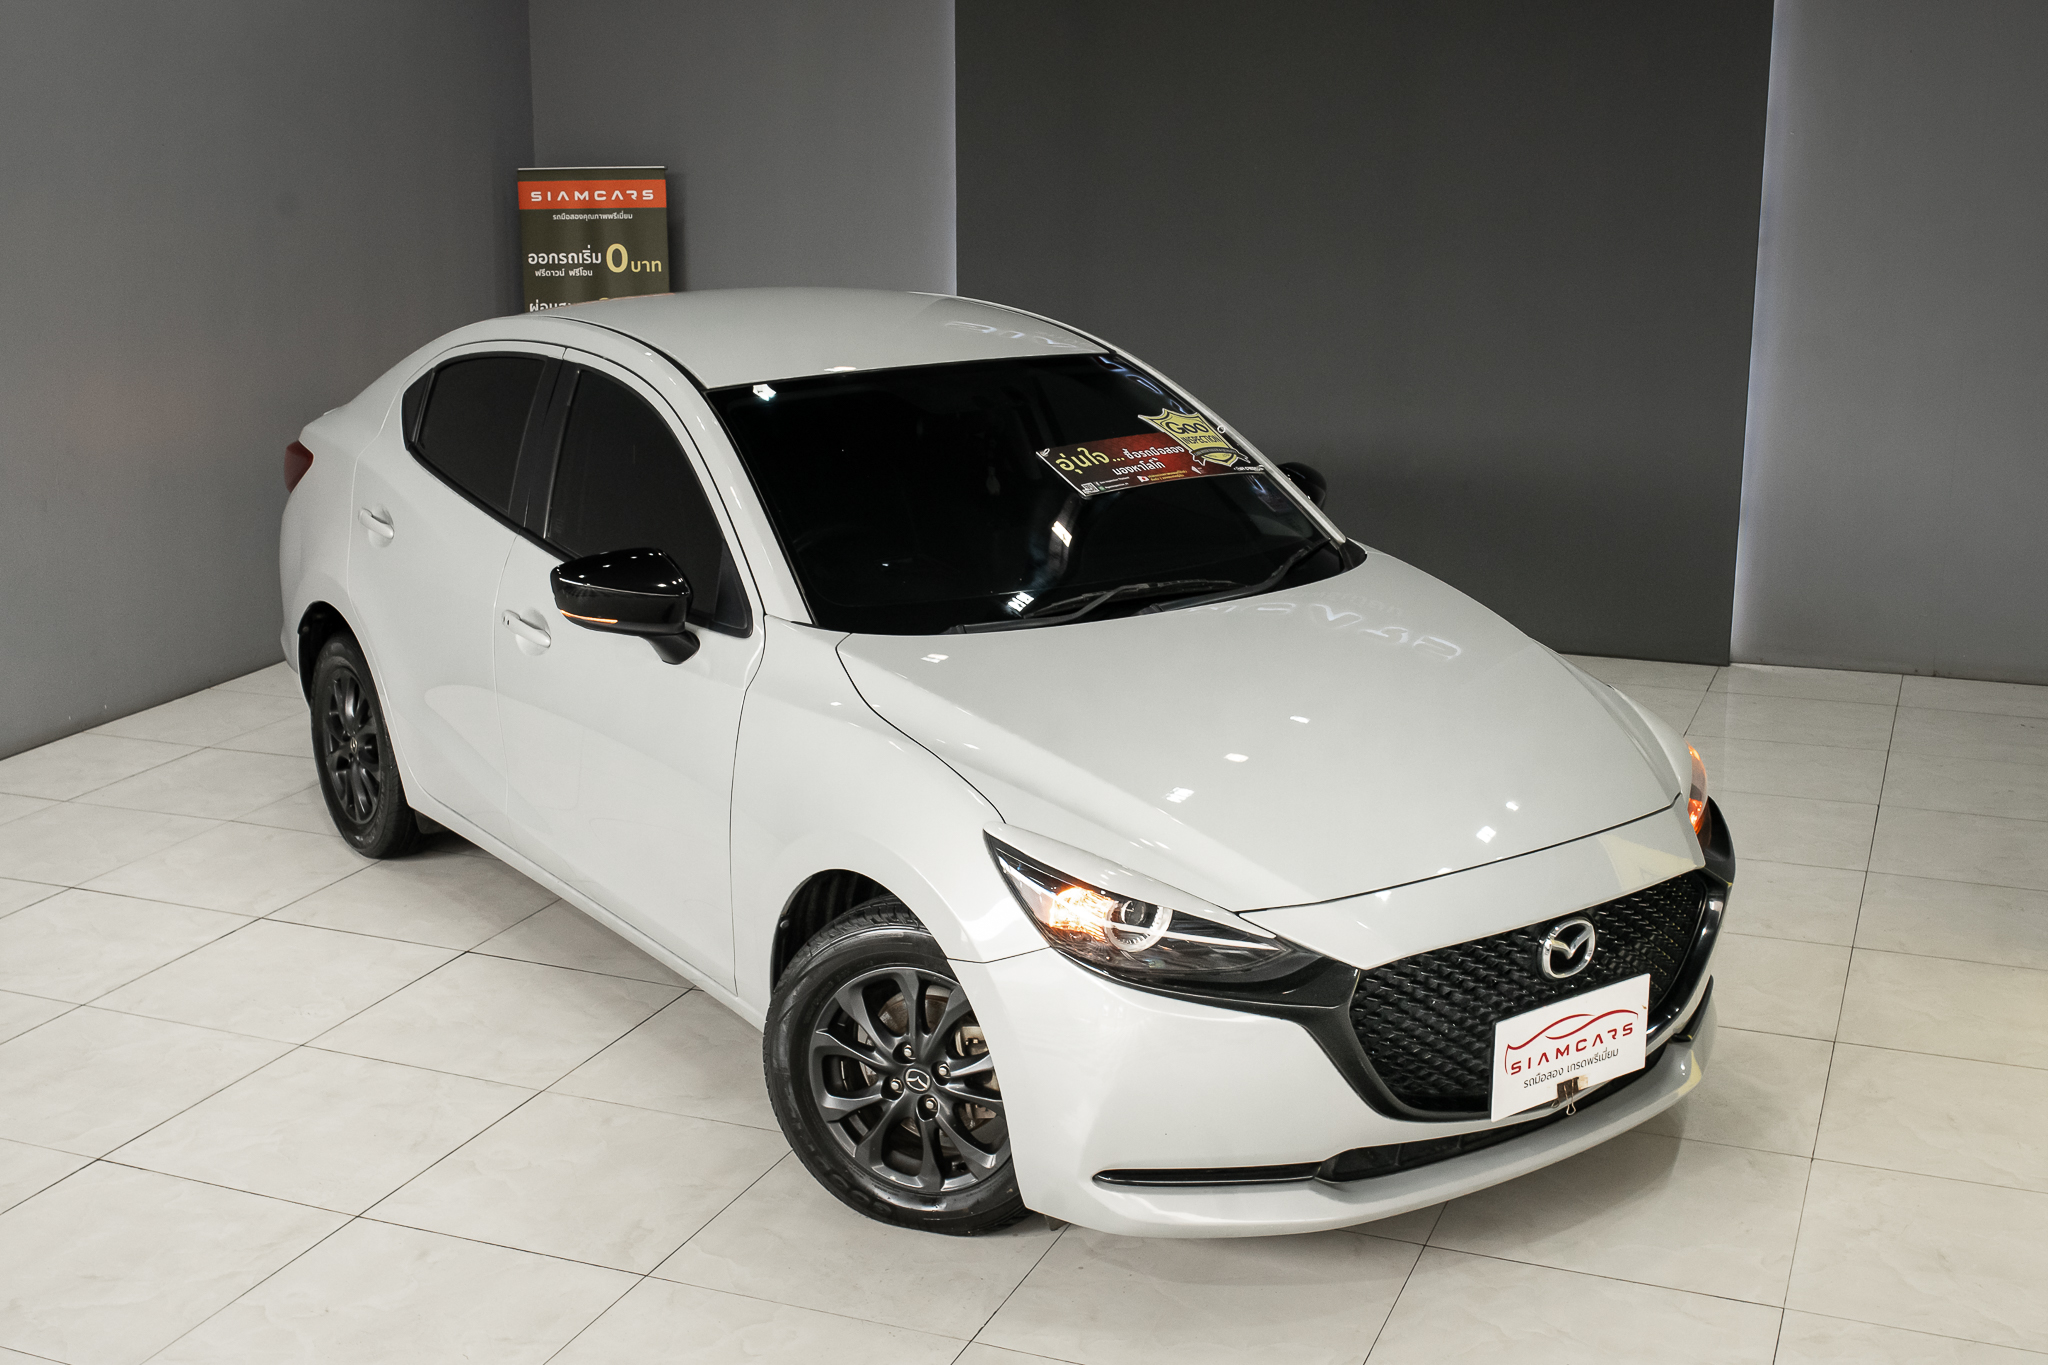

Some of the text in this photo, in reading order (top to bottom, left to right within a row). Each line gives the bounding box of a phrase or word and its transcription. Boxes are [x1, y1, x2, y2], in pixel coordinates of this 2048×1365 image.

[531, 189, 654, 202] SIAMCARS
[528, 243, 662, 273] ออกรถเริ่ม 0 บาท
[535, 267, 565, 277] ฟรีดาวน์
[1165, 421, 1210, 435] Goo
[1510, 1022, 1634, 1076] SIAMCARS
[1523, 1066, 1564, 1089] รถมือสอง
